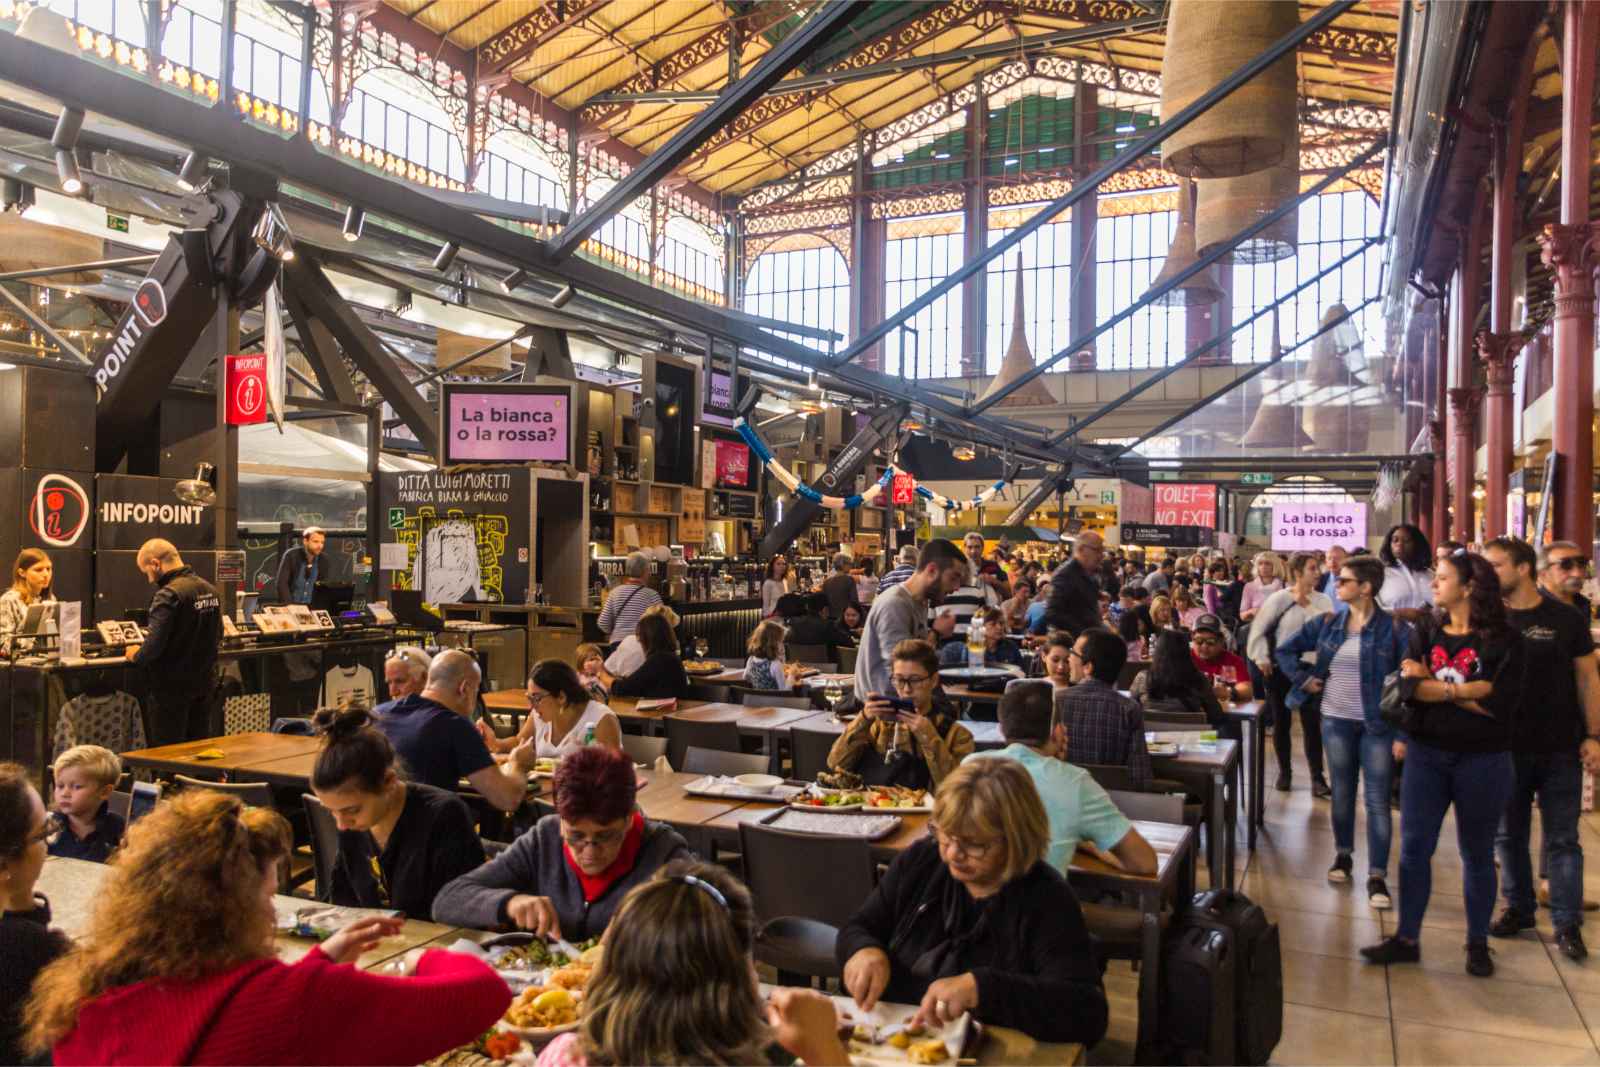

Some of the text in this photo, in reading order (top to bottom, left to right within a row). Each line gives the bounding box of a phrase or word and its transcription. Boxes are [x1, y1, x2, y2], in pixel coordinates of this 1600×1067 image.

[95, 314, 143, 403] POINT
[461, 407, 553, 423] La bianca
[457, 426, 557, 441] o la rossa?
[398, 473, 510, 490] DITTA LUIGI MORETTI
[438, 490, 463, 503] BIRRA
[1155, 486, 1199, 504] TOILET
[103, 501, 203, 525] INFOPOINT
[1155, 510, 1215, 526] NO EXIT
[1282, 512, 1352, 524] La bianca
[1279, 526, 1355, 537] o la rossa?
